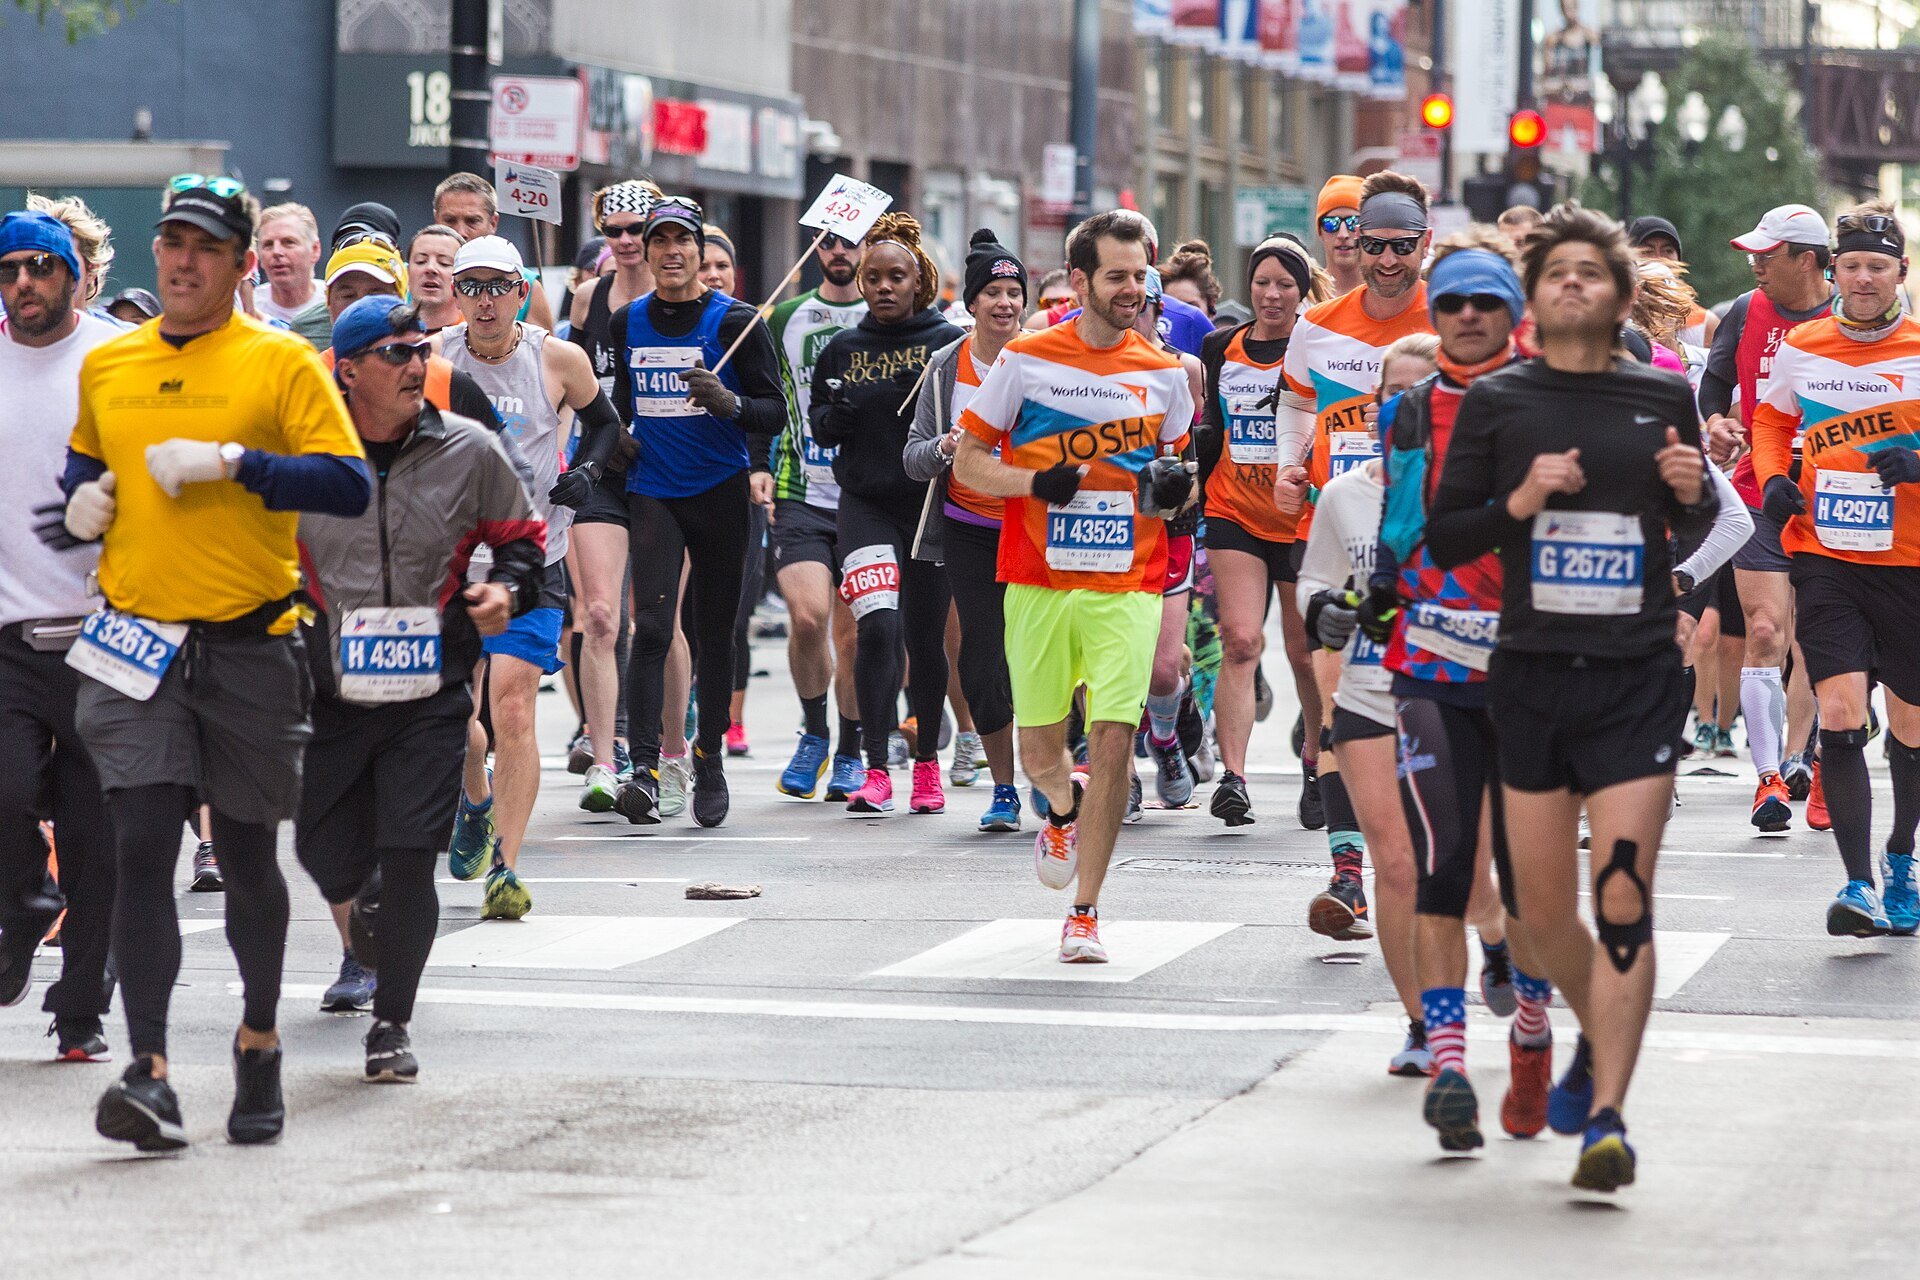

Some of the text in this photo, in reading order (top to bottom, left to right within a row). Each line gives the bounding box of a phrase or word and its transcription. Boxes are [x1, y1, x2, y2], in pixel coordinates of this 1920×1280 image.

[407, 70, 450, 125] 18
[511, 188, 548, 207] 4:20
[863, 186, 888, 201] JEFF
[825, 201, 860, 221] 4:20
[1326, 359, 1380, 373] World Vi
[636, 372, 647, 392] H
[1050, 385, 1130, 401] World Vision
[1228, 383, 1255, 394] World
[1807, 380, 1888, 393] World Vision
[1058, 417, 1144, 466] JOSH
[1233, 419, 1276, 440] H 436
[1807, 410, 1897, 457] JAEMIE
[1817, 497, 1890, 524] H 42974
[1053, 517, 1129, 545] H 43525
[1540, 545, 1635, 580] G 26721
[849, 566, 896, 594] 16612
[83, 611, 106, 636] G
[97, 614, 168, 671] 32612
[348, 640, 437, 670] H 43614
